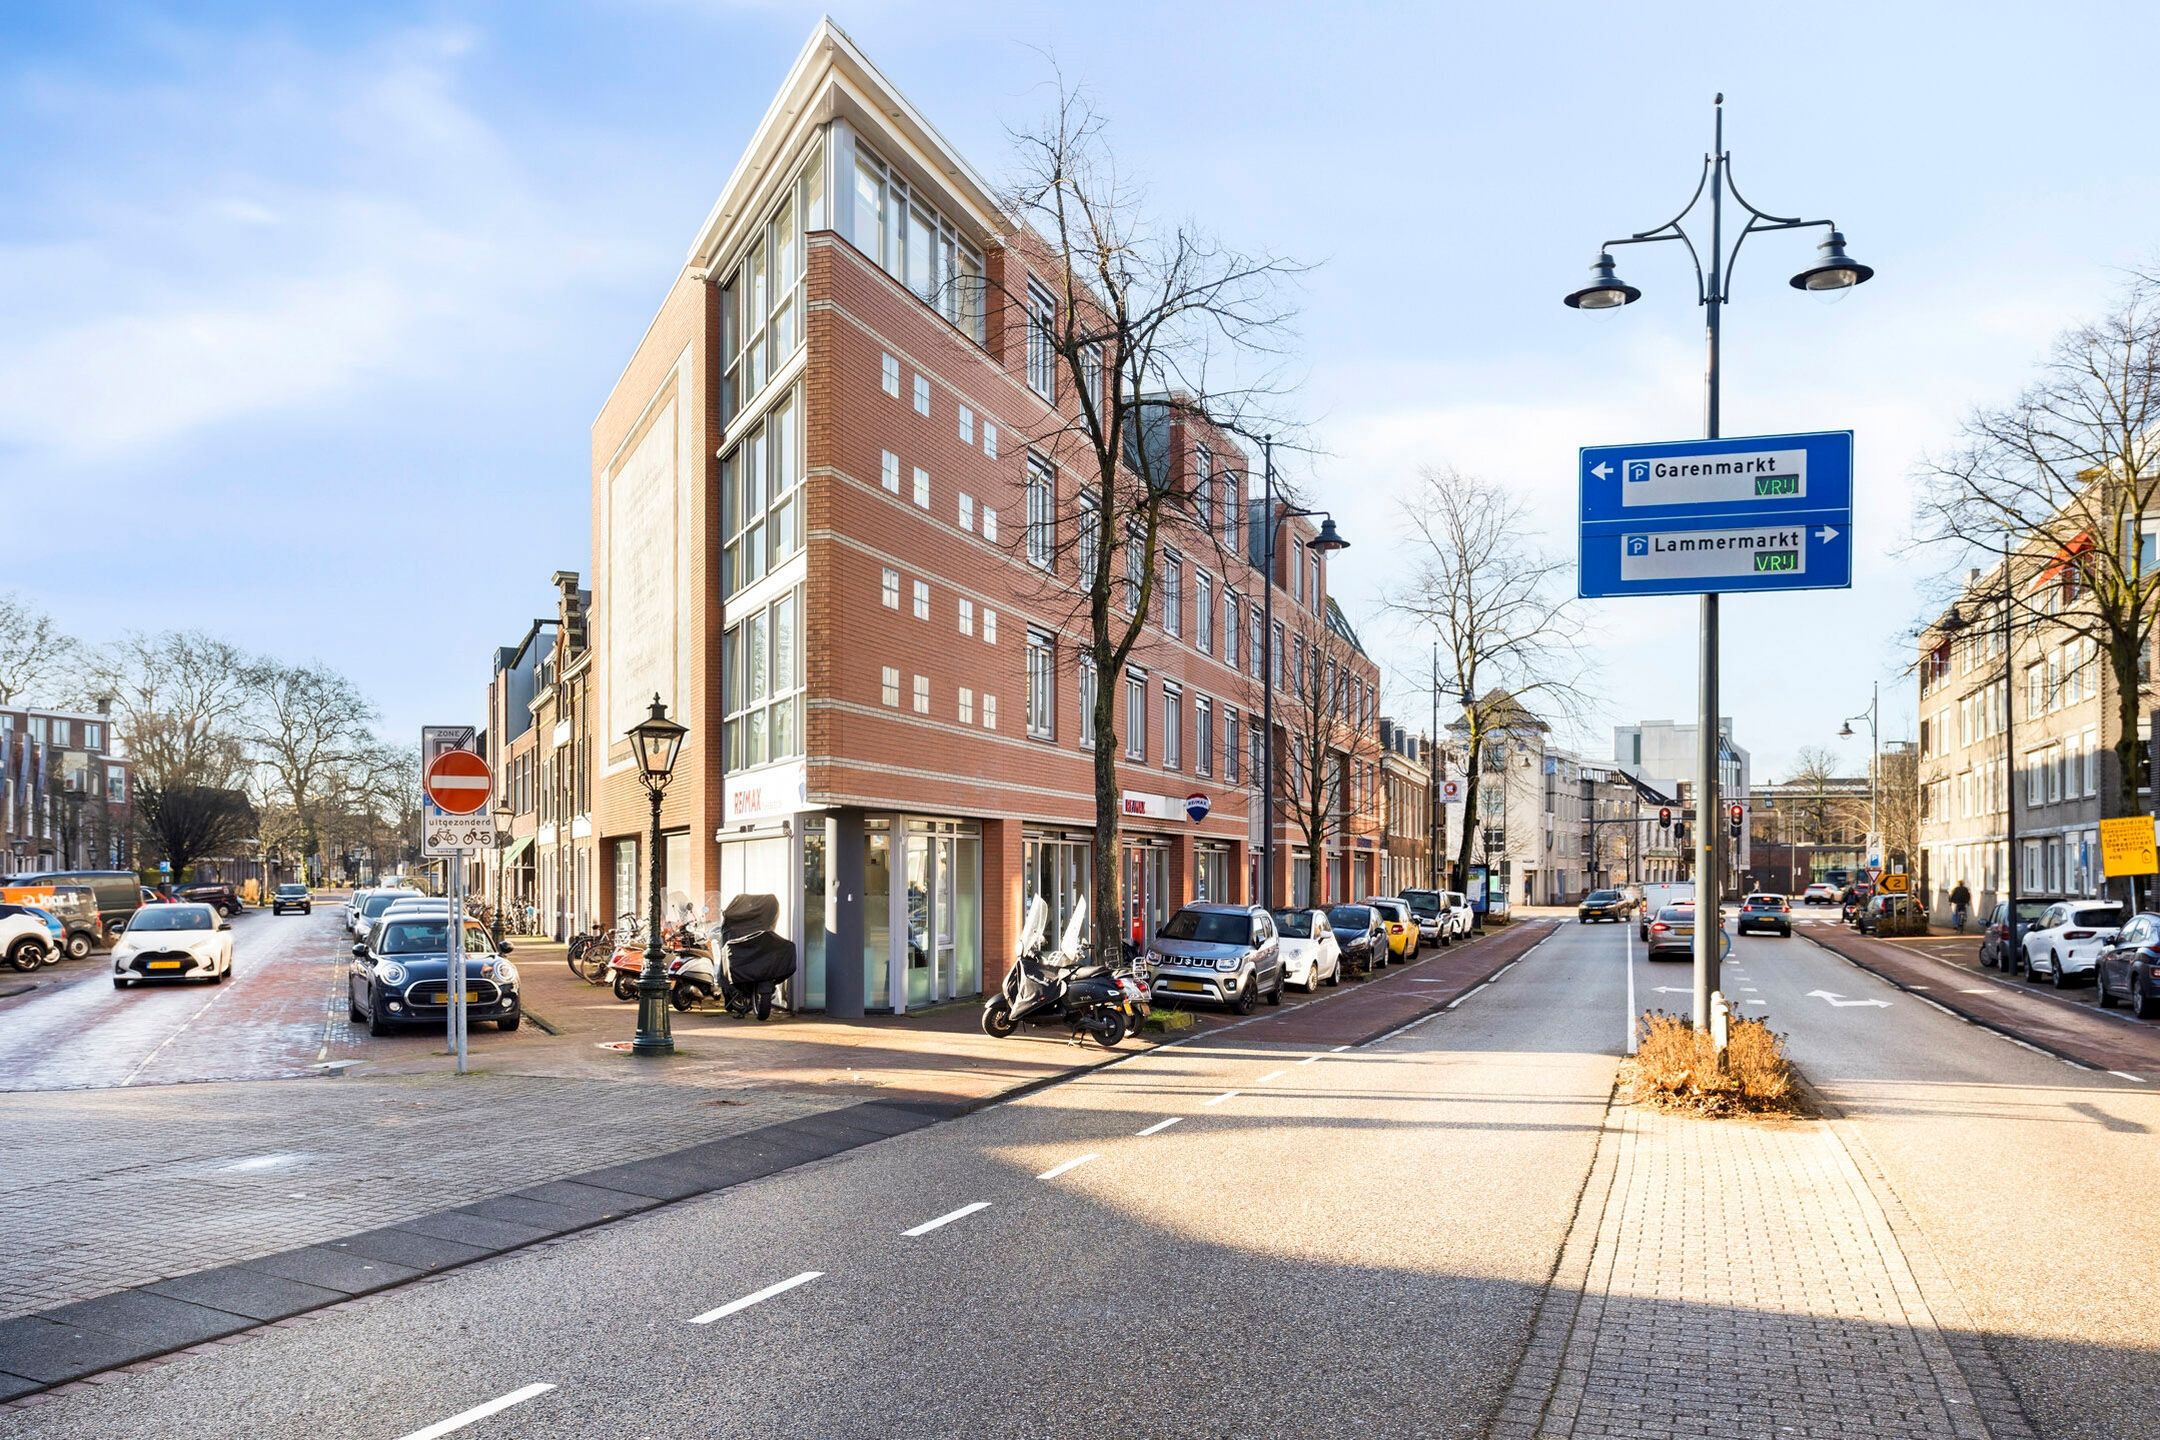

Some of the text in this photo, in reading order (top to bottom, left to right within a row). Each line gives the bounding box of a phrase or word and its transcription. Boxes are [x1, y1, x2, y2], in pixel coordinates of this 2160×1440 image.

[1655, 457, 1776, 478] Garenmarkt
[1757, 478, 1795, 496] VRIJ
[1655, 531, 1799, 552] Lammermarkt
[1756, 554, 1795, 571] VRIJ
[735, 788, 761, 814] RE/MAX
[429, 819, 491, 827] uitgezonderd
[1893, 879, 1901, 888] 2
